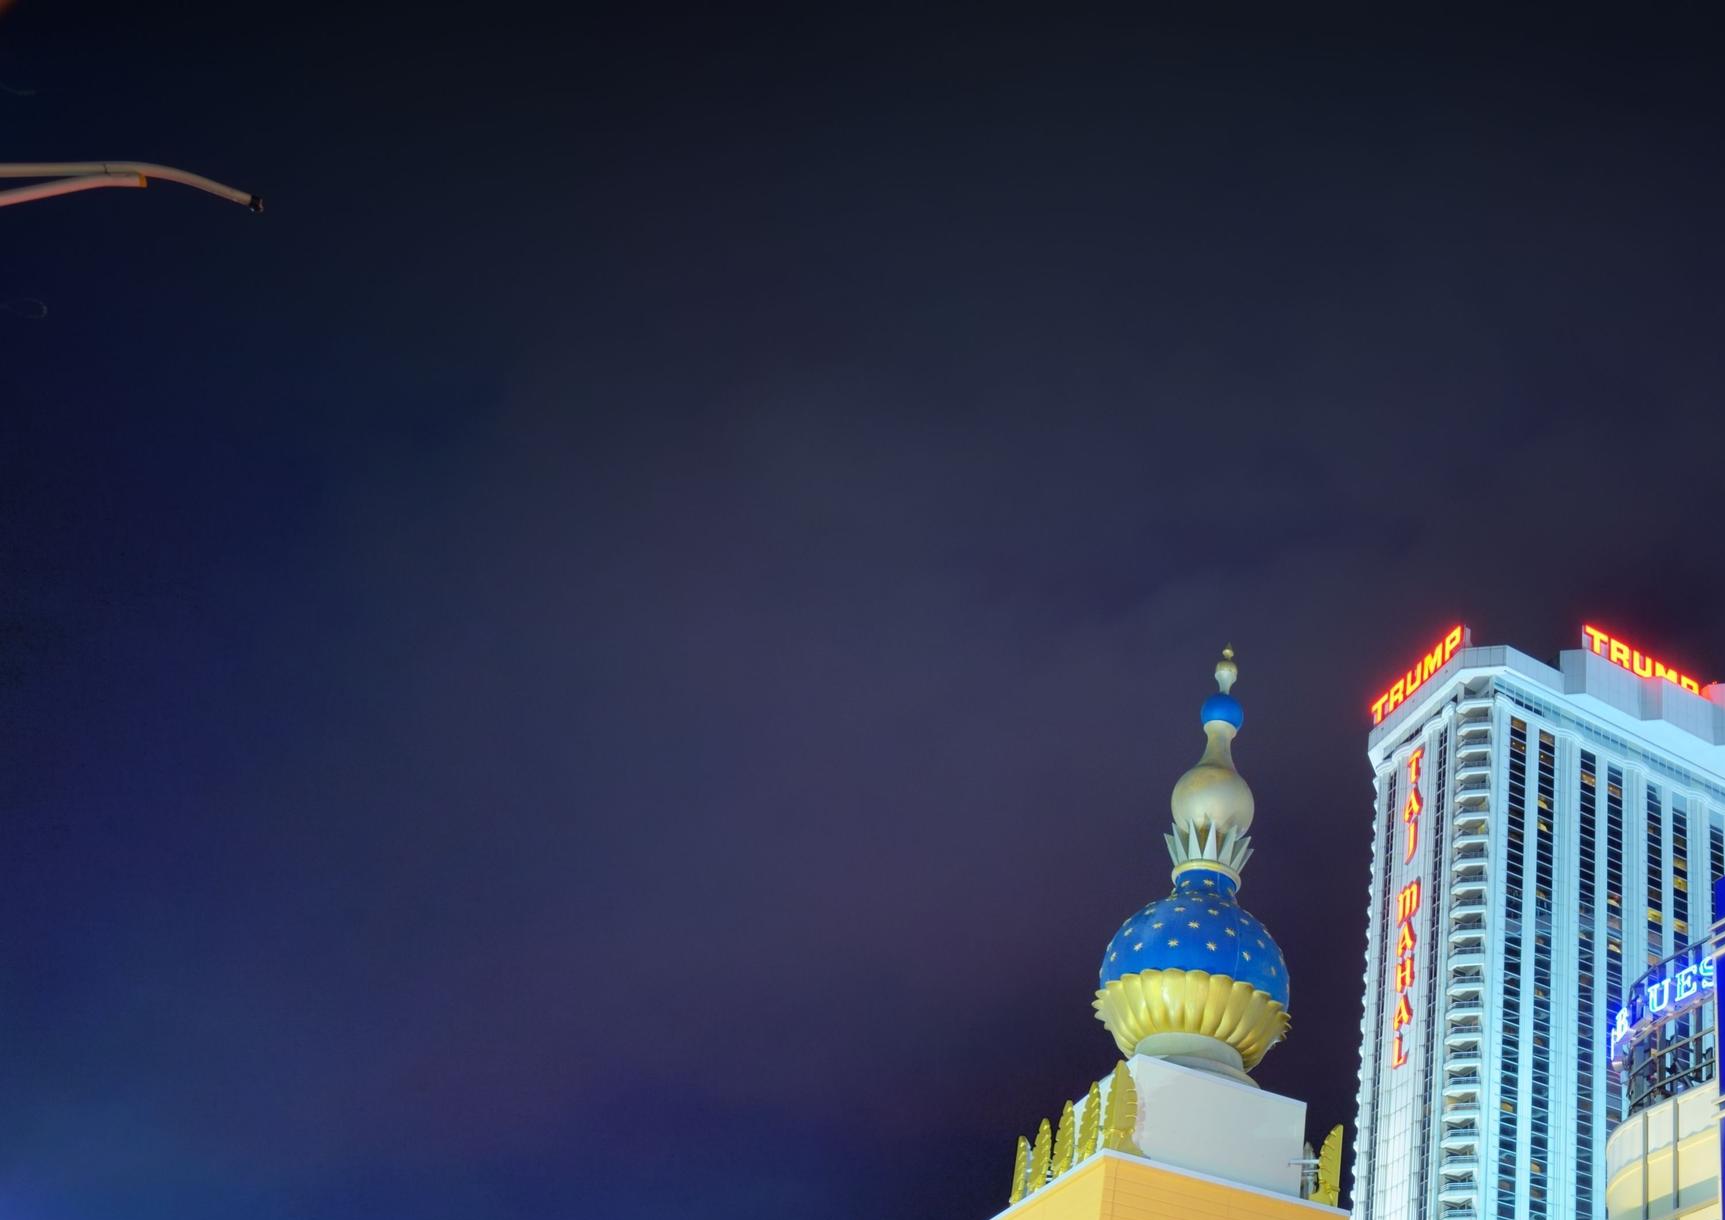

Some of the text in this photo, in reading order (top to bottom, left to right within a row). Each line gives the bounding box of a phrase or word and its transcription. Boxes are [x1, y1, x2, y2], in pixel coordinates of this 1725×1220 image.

[1371, 625, 1462, 724] TRUMP
[1585, 624, 1700, 696] TRUMP
[1392, 746, 1424, 1070] TAJ MAHAL
